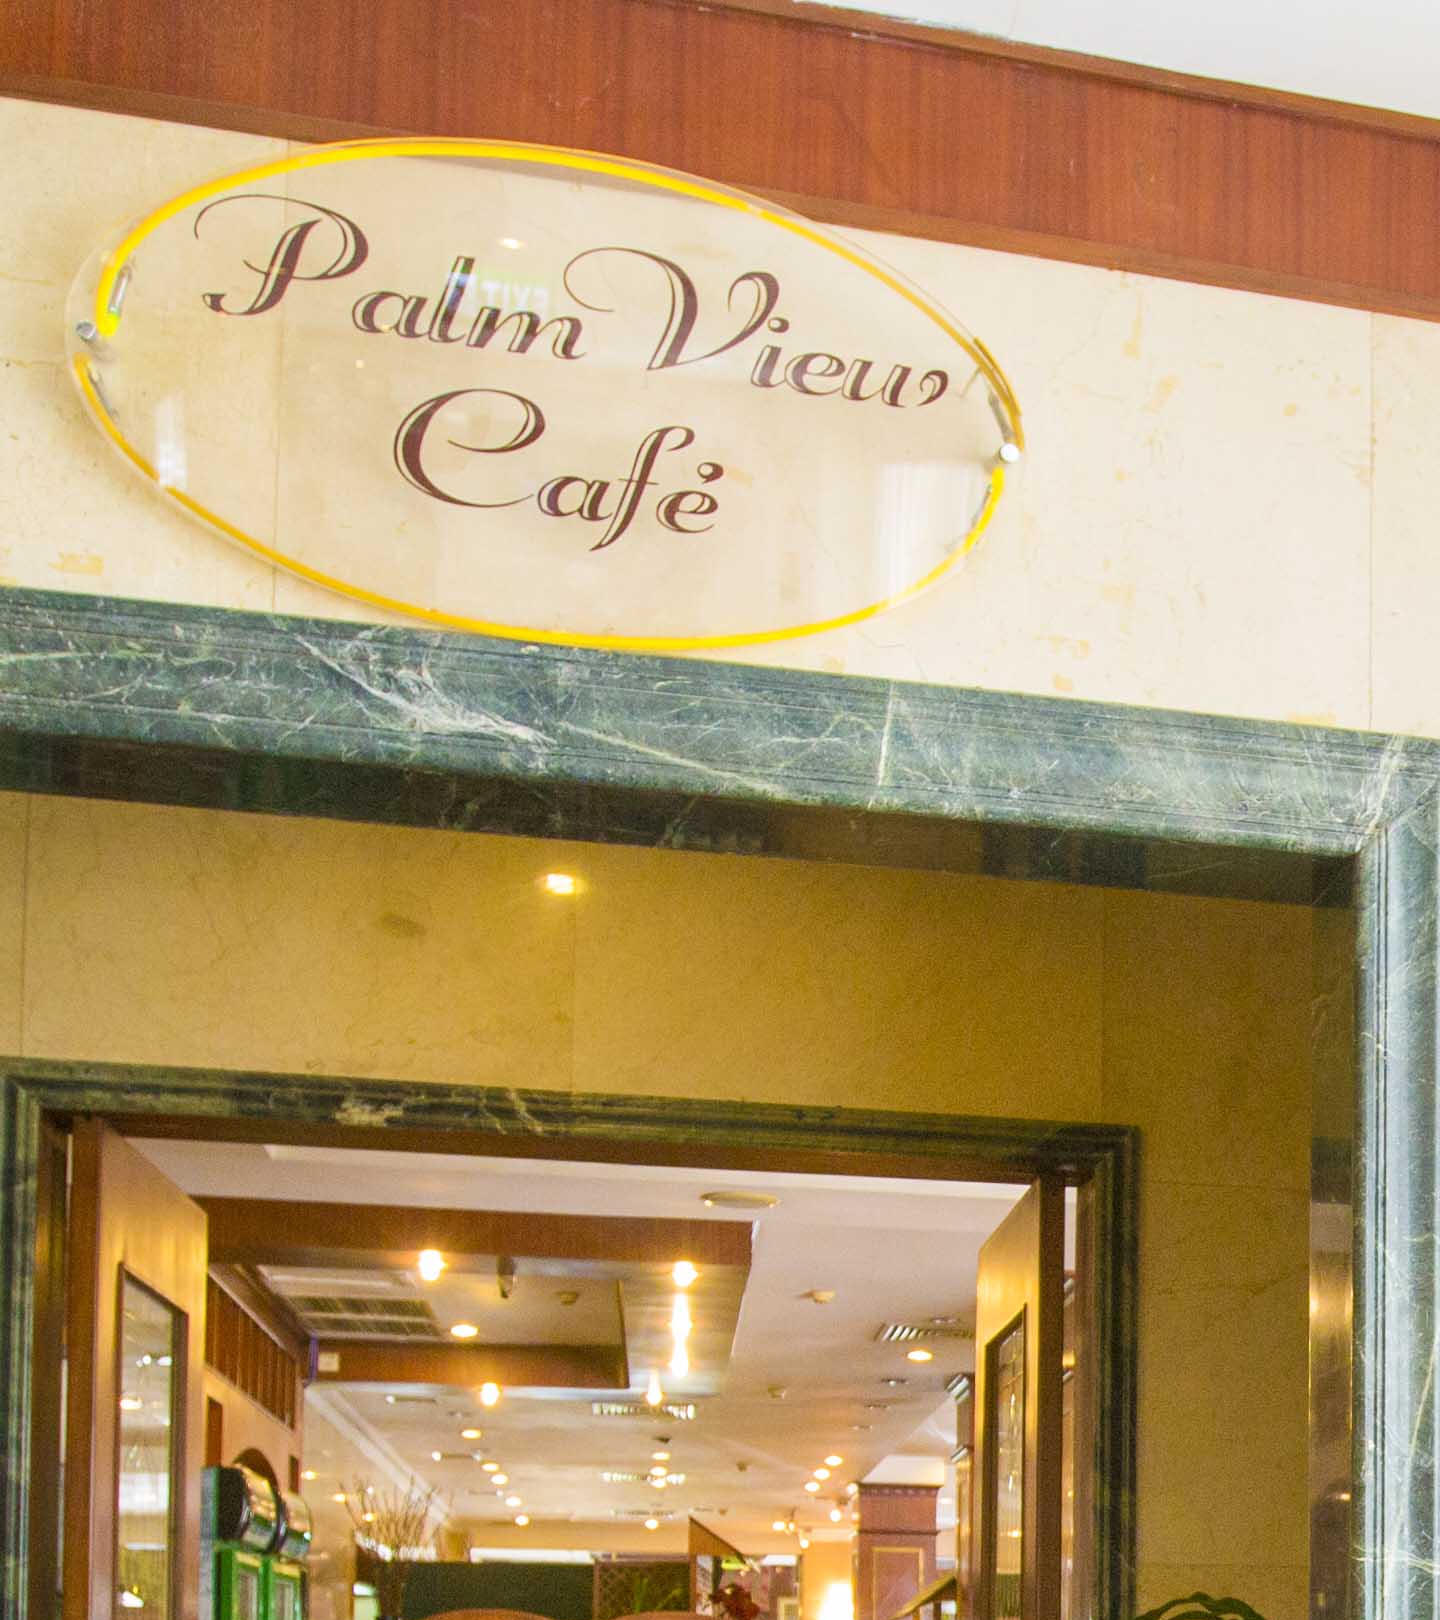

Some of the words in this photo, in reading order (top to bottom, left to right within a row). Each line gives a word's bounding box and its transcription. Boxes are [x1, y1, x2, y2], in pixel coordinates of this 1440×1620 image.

[193, 193, 586, 361] Palm
[562, 246, 948, 408] View
[393, 388, 725, 553] Café
